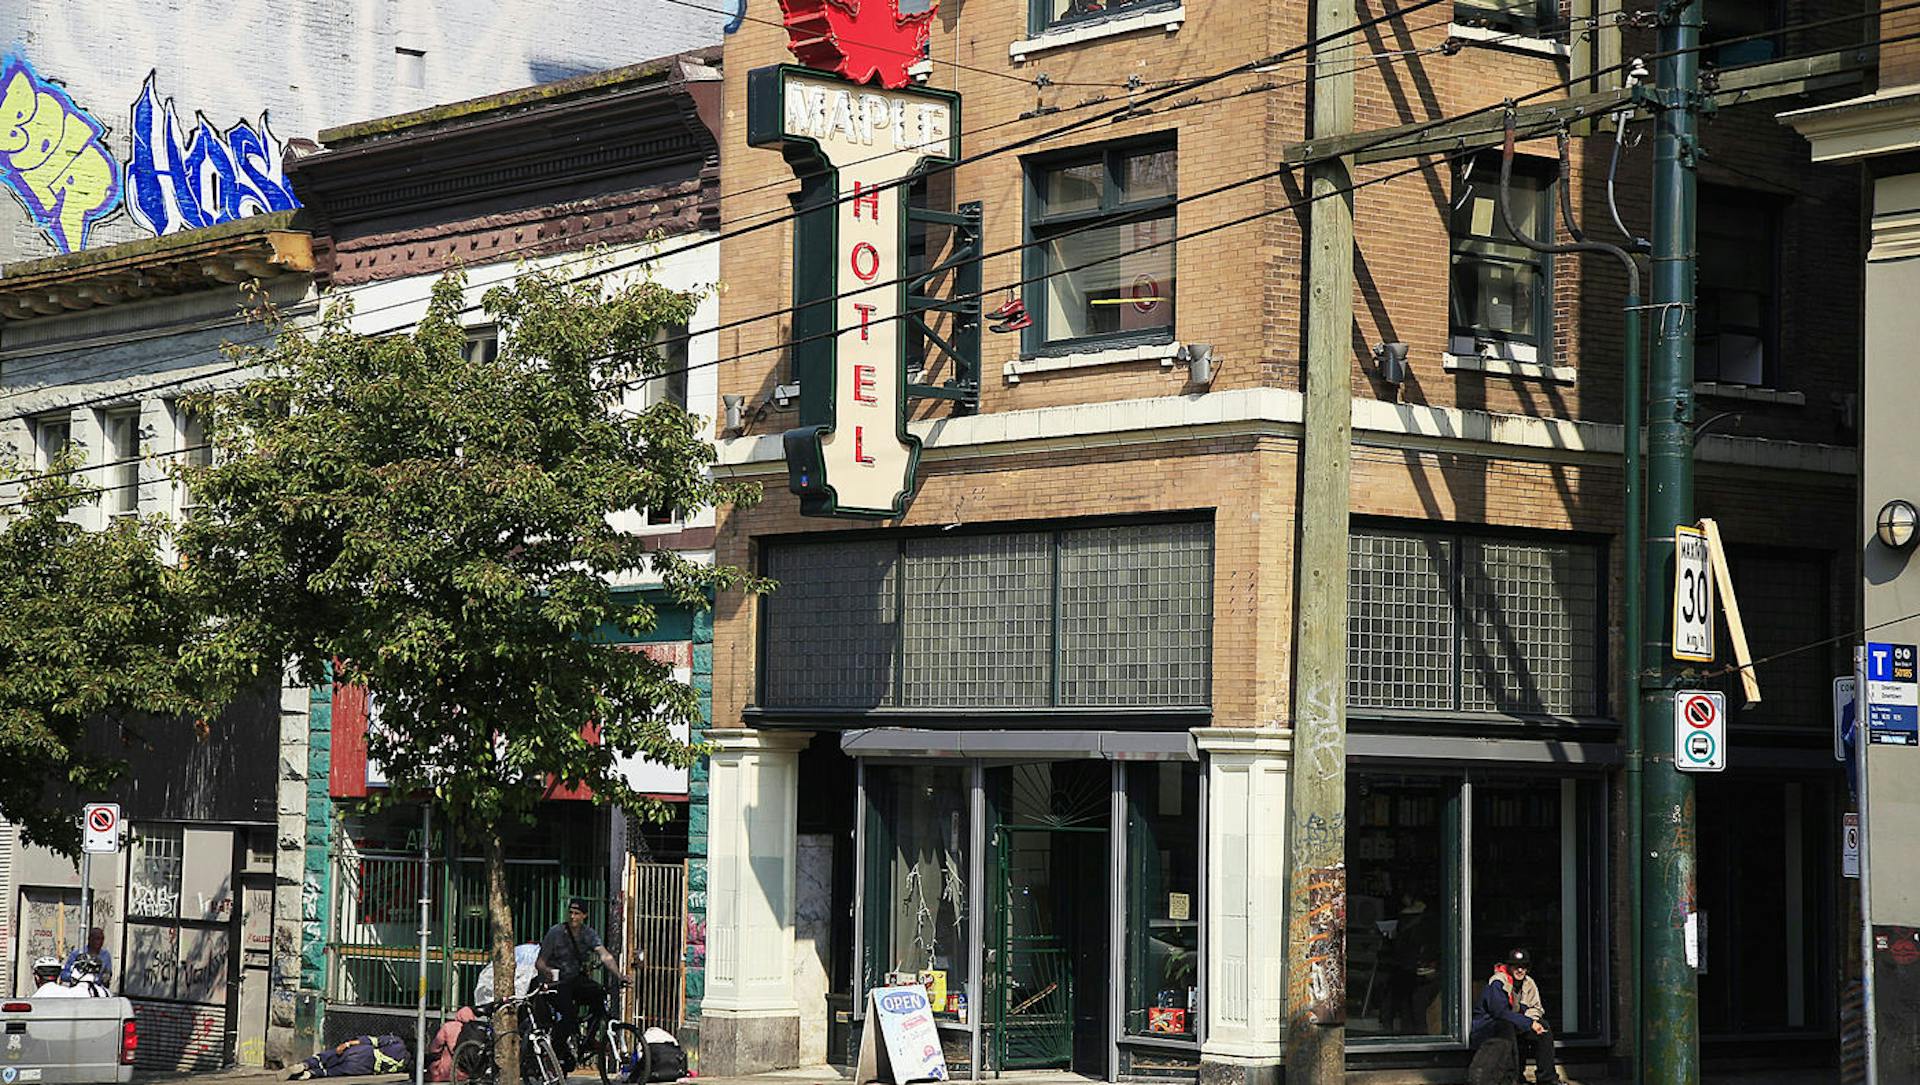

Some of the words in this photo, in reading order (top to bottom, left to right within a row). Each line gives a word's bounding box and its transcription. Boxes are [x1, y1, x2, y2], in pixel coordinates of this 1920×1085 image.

[784, 81, 947, 155] MAPLE
[851, 181, 880, 468] HOTEL
[1683, 567, 1708, 625] 30
[1872, 650, 1888, 676] T
[884, 994, 922, 1011] OPEN
